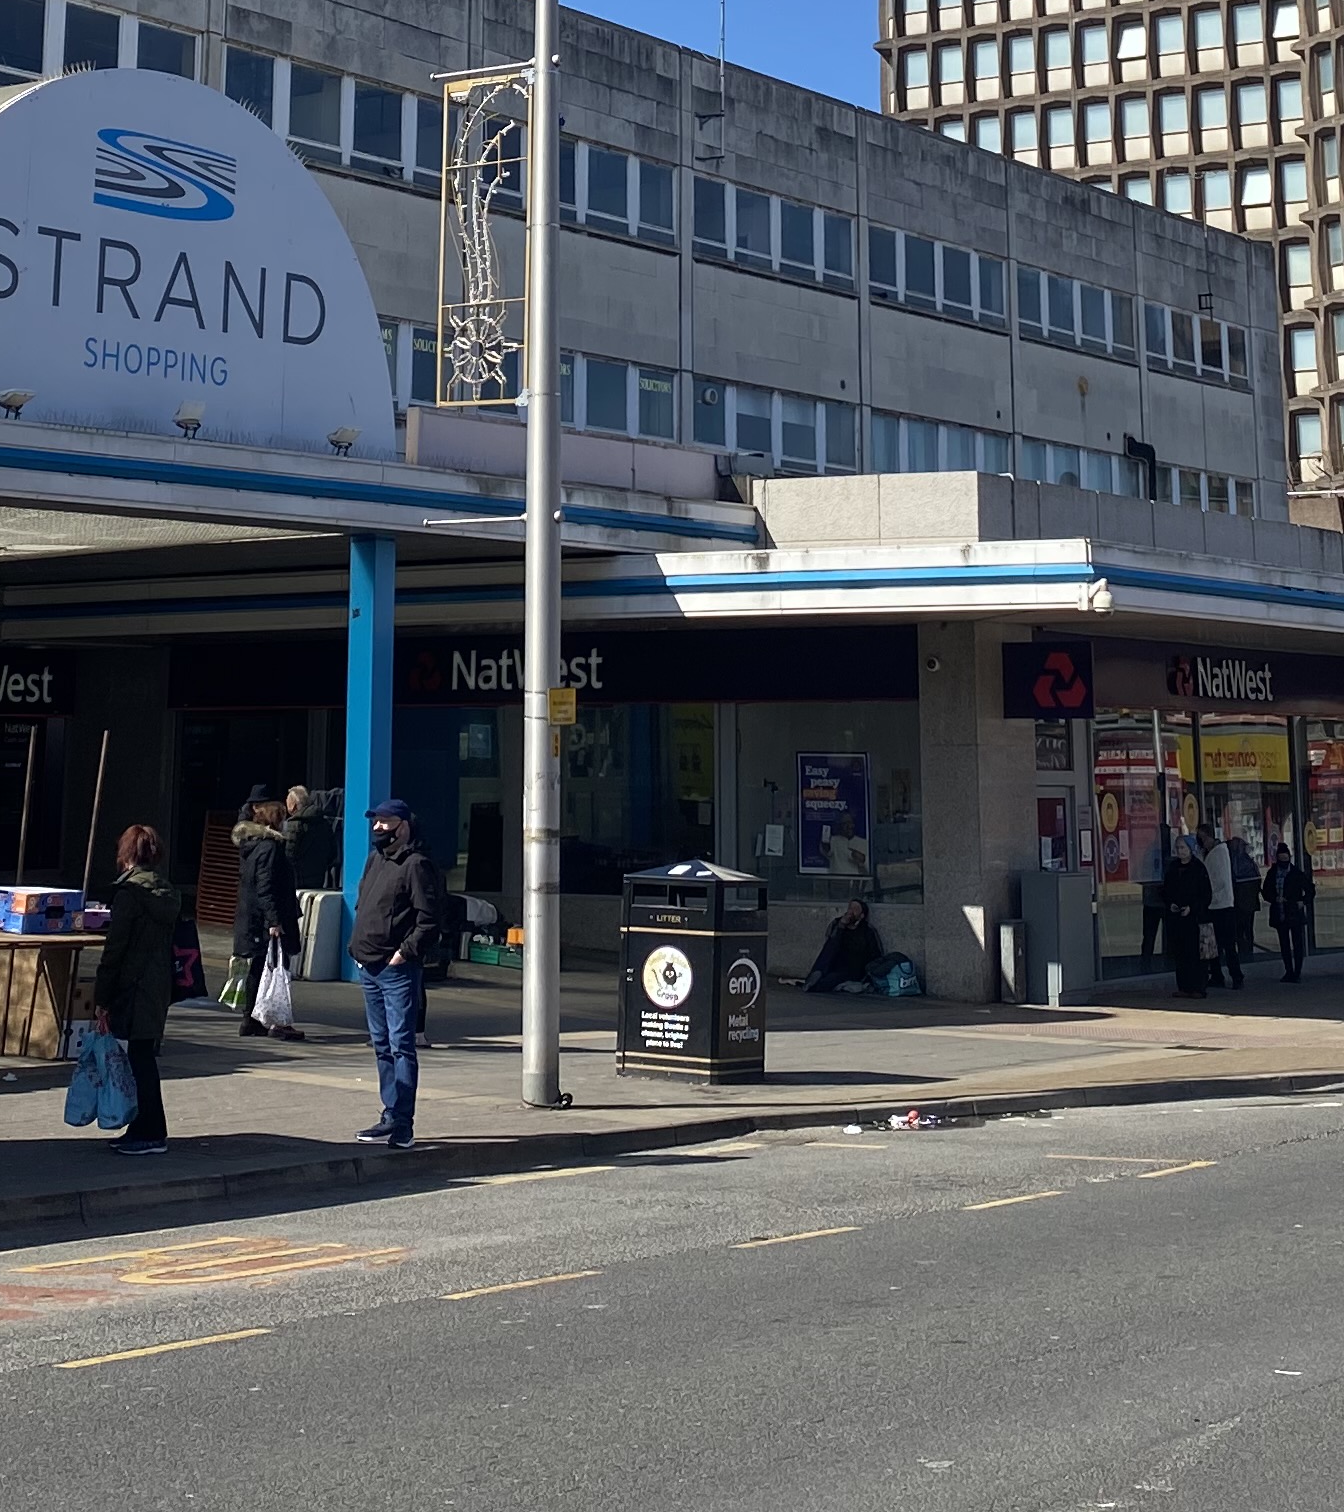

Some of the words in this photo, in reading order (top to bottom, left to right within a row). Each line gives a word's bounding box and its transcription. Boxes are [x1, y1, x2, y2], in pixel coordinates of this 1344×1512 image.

[83, 337, 228, 386] SHOPPING
[1197, 656, 1274, 701] NatWest
[805, 765, 830, 778] Easy
[656, 914, 682, 923] LITTER
[729, 1014, 749, 1028] Metal
[728, 1027, 759, 1043] recycling
